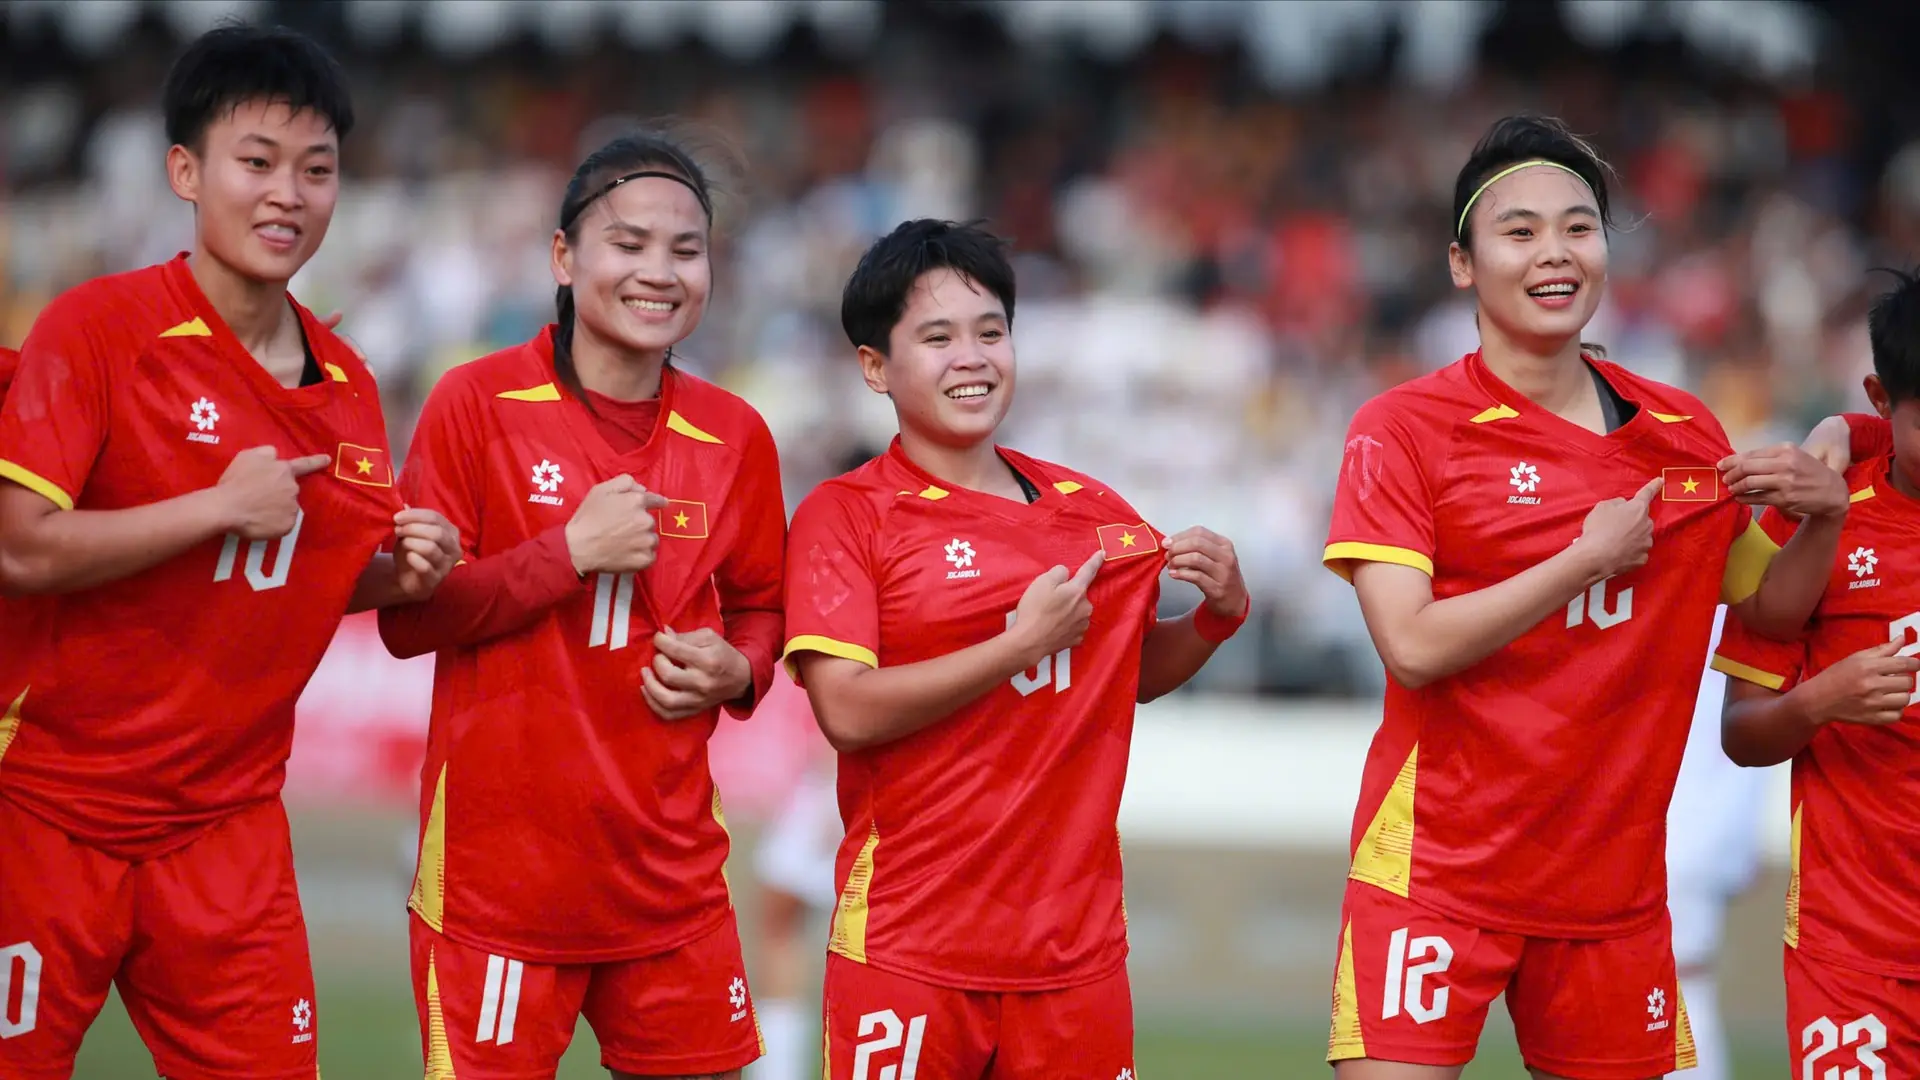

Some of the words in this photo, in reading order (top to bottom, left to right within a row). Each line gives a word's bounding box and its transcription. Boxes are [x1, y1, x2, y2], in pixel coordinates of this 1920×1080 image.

[1507, 496, 1541, 505] JOCARBOLA
[946, 569, 980, 580] JOCARBOLA
[475, 954, 523, 1046] 11
[1382, 928, 1454, 1024] 12
[852, 1008, 928, 1080] 21
[1802, 1013, 1887, 1080] 23
